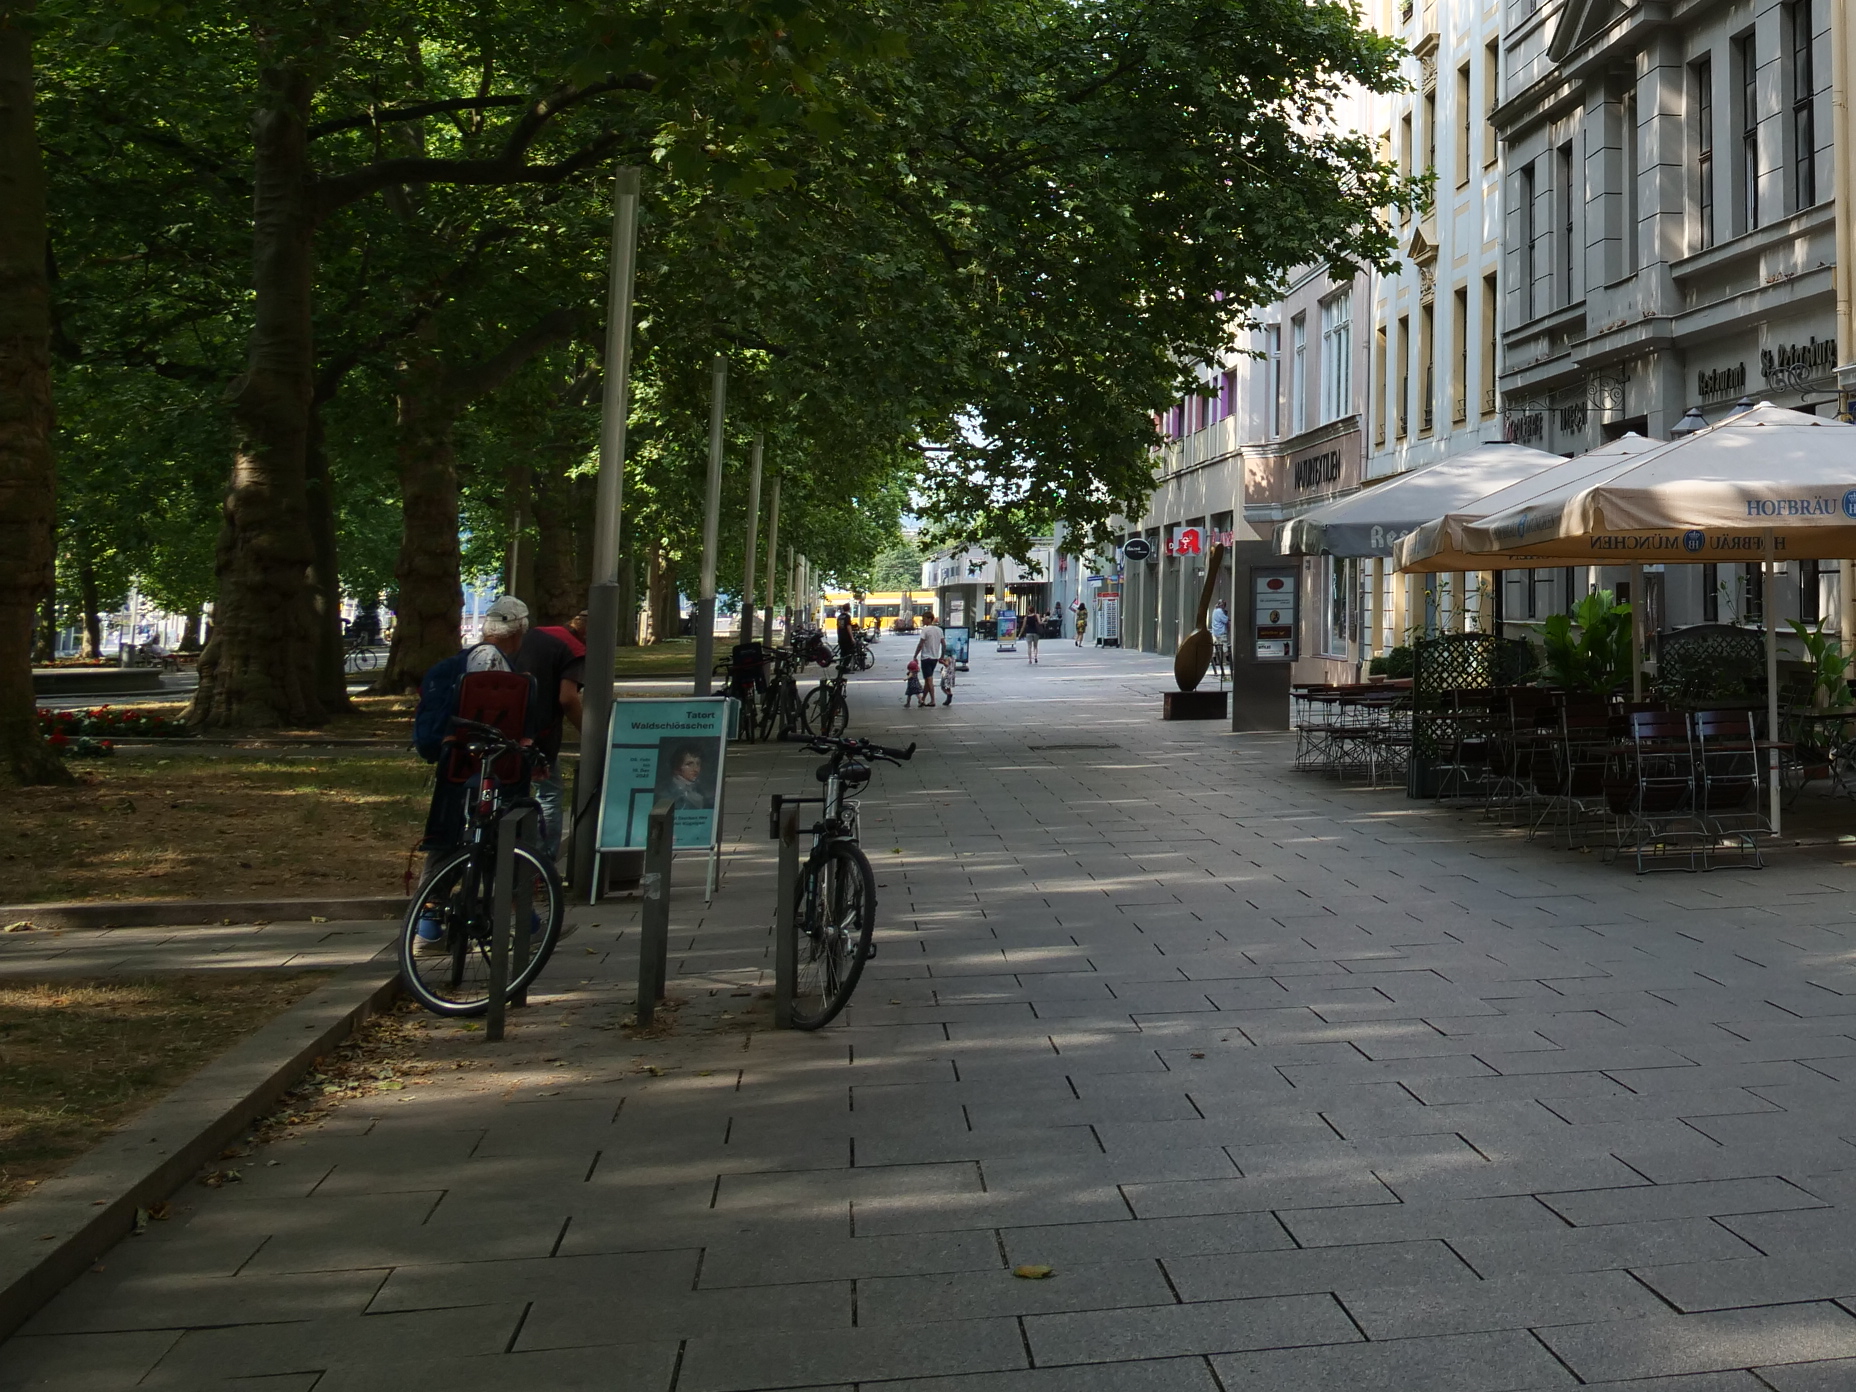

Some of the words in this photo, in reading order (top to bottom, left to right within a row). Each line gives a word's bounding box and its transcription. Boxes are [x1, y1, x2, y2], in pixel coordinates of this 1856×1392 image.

[1698, 362, 1746, 396] Restaurant
[1746, 496, 1837, 516] HOFBRÄU
[686, 711, 715, 719] Tatort
[631, 721, 715, 730] Waldschlösschen
